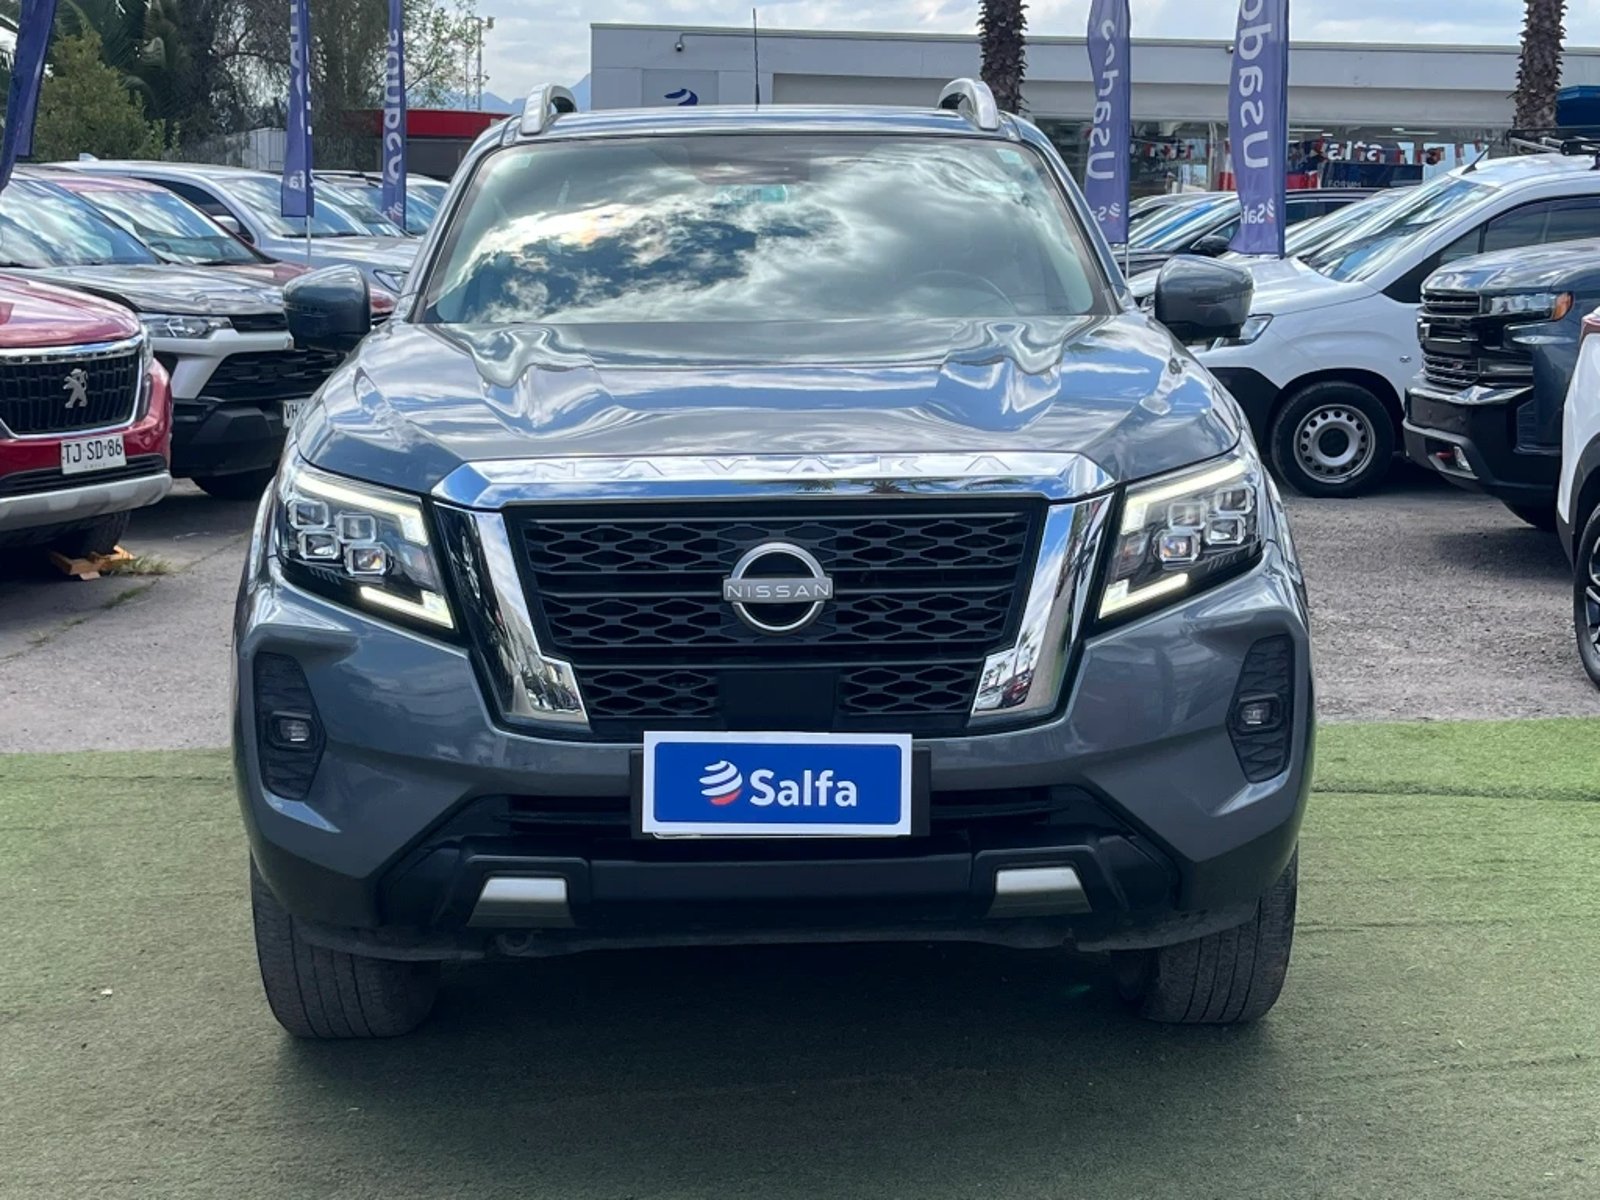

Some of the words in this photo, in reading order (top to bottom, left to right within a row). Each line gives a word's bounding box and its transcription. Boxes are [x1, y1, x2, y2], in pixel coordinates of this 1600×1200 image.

[534, 455, 1012, 480] NAVARA
[727, 584, 830, 599] NISSAN
[749, 768, 858, 808] Salfa
